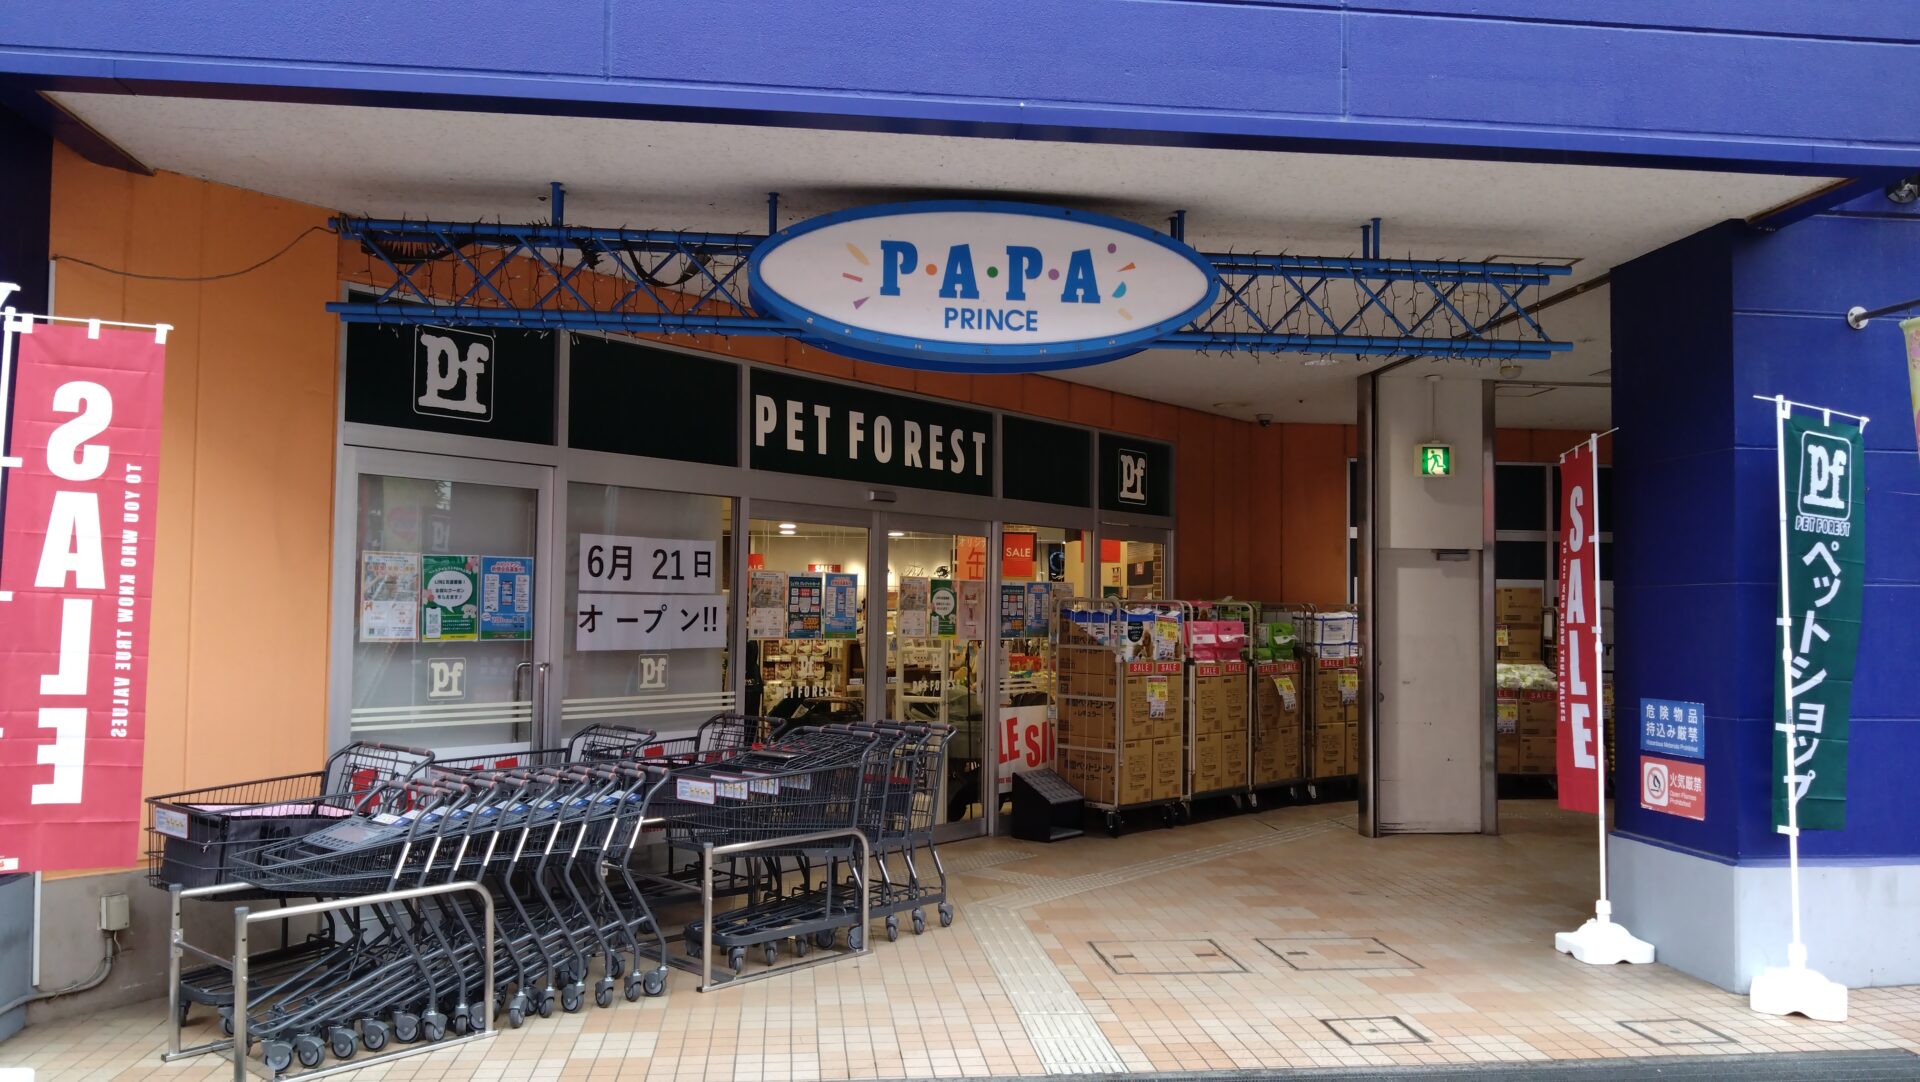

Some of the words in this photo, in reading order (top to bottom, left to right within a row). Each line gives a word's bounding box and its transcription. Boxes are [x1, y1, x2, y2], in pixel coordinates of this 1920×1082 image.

[944, 307, 1038, 332] PRINCE
[755, 394, 830, 456] PET
[848, 410, 986, 476] FOREST
[1795, 515, 1816, 532] PET
[1815, 518, 1850, 537] FOREST
[1006, 547, 1031, 558] SALE
[588, 545, 632, 581] 6月
[652, 549, 711, 581] 21日
[1566, 486, 1596, 769] SALE
[1133, 663, 1149, 672] SALE
[1161, 663, 1177, 672] SALE
[1203, 667, 1217, 675] SALE
[1228, 664, 1242, 672] SALE
[1784, 541, 1841, 809] ペットショップ
[1646, 704, 1698, 724] 危険物品
[1646, 722, 1698, 743] 持込み厳禁
[1669, 773, 1702, 793] 火気厳禁
